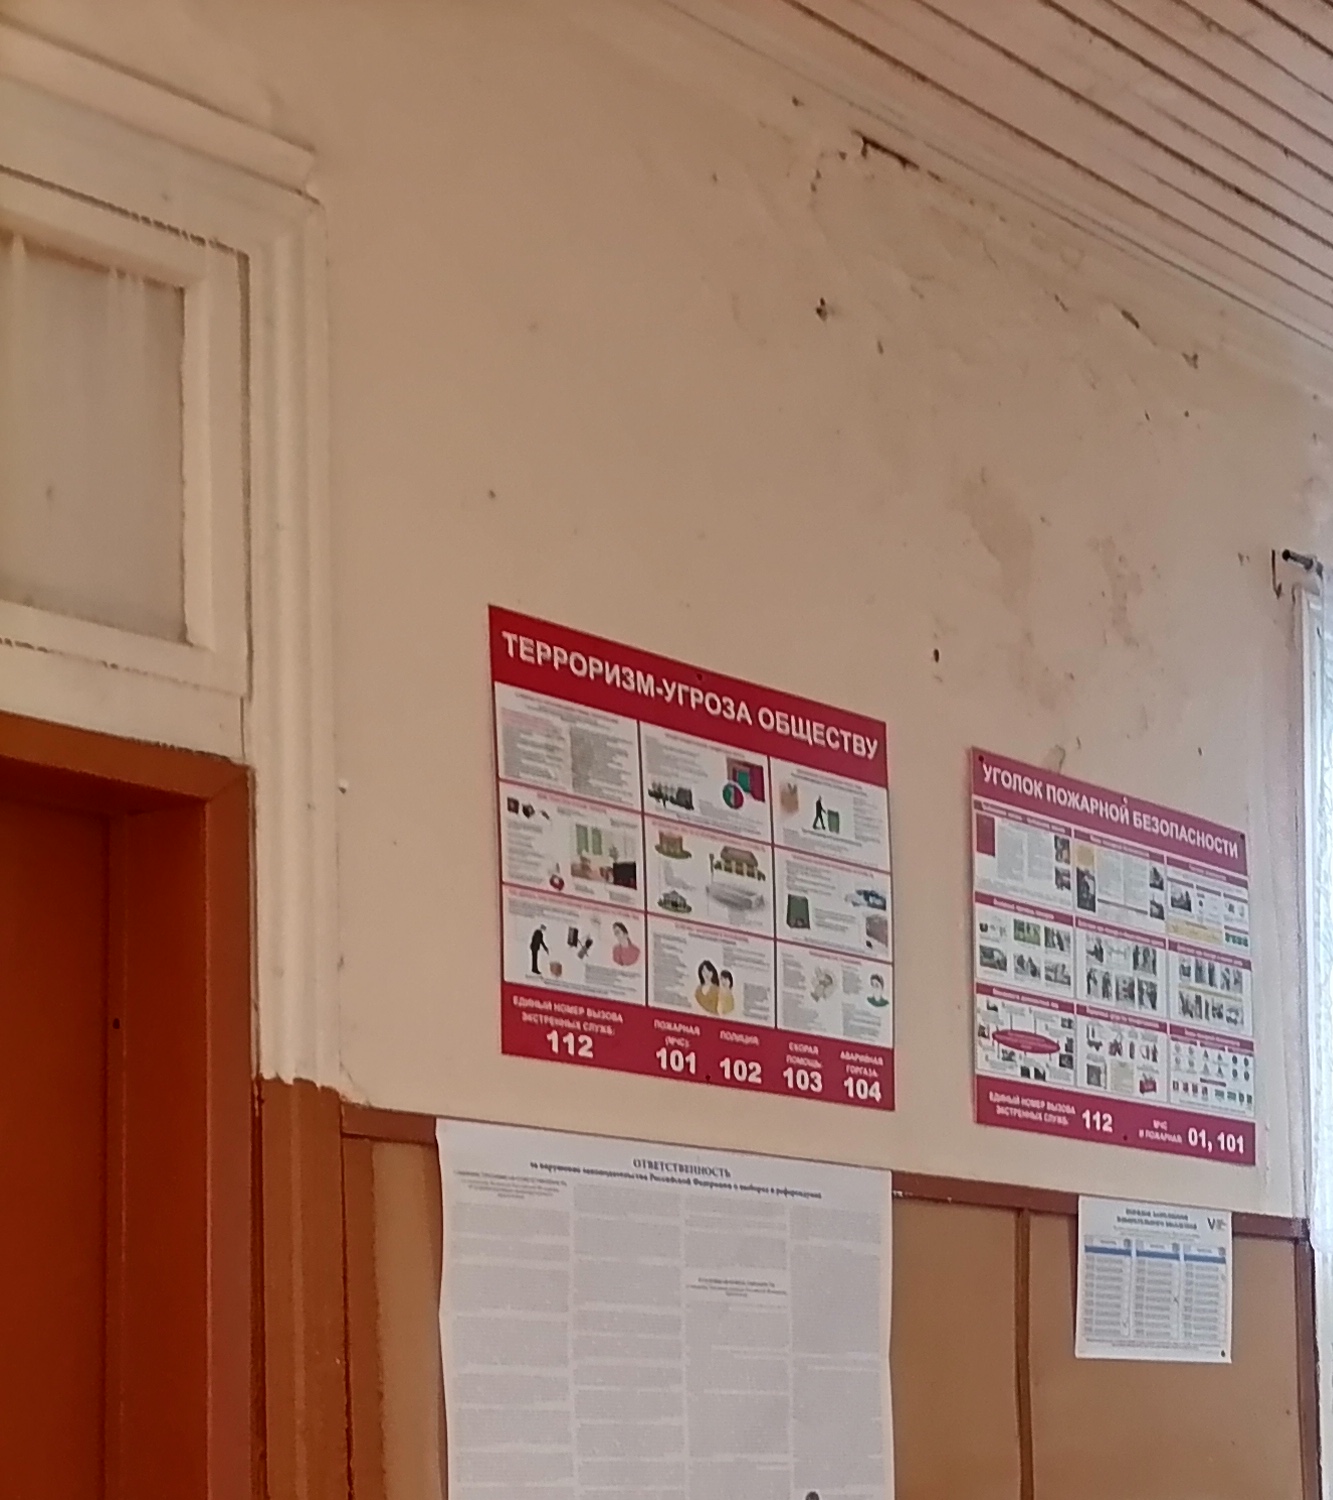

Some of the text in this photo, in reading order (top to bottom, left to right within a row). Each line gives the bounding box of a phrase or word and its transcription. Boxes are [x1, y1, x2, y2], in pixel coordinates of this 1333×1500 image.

[501, 630, 879, 762] ТЕРРОРИЗМ-УГРОЗА ОБЩЕСТВУ
[982, 763, 1043, 800] УГОЛОК
[1045, 784, 1130, 826] ПОЖАРНОЙ
[1132, 809, 1239, 860] БЕЗОПАСНОСТИ
[512, 994, 624, 1024] ЕДИНЫЙ НОМЕР ВЫЗОВА
[521, 1011, 582, 1031] ЭКСТРЕННЫХ
[654, 1019, 701, 1037] ПОЖАРНАЯ
[546, 1029, 595, 1059] 112
[788, 1042, 819, 1055] СКОРАЯ
[655, 1047, 697, 1075] 101
[719, 1057, 762, 1084] 102
[782, 1066, 823, 1093] 103
[843, 1076, 882, 1103] 104
[1081, 1108, 1114, 1133] 112
[1188, 1127, 1244, 1154] 01, 101
[632, 1157, 732, 1179] ОТВЕТСТВЕННОСТЬ
